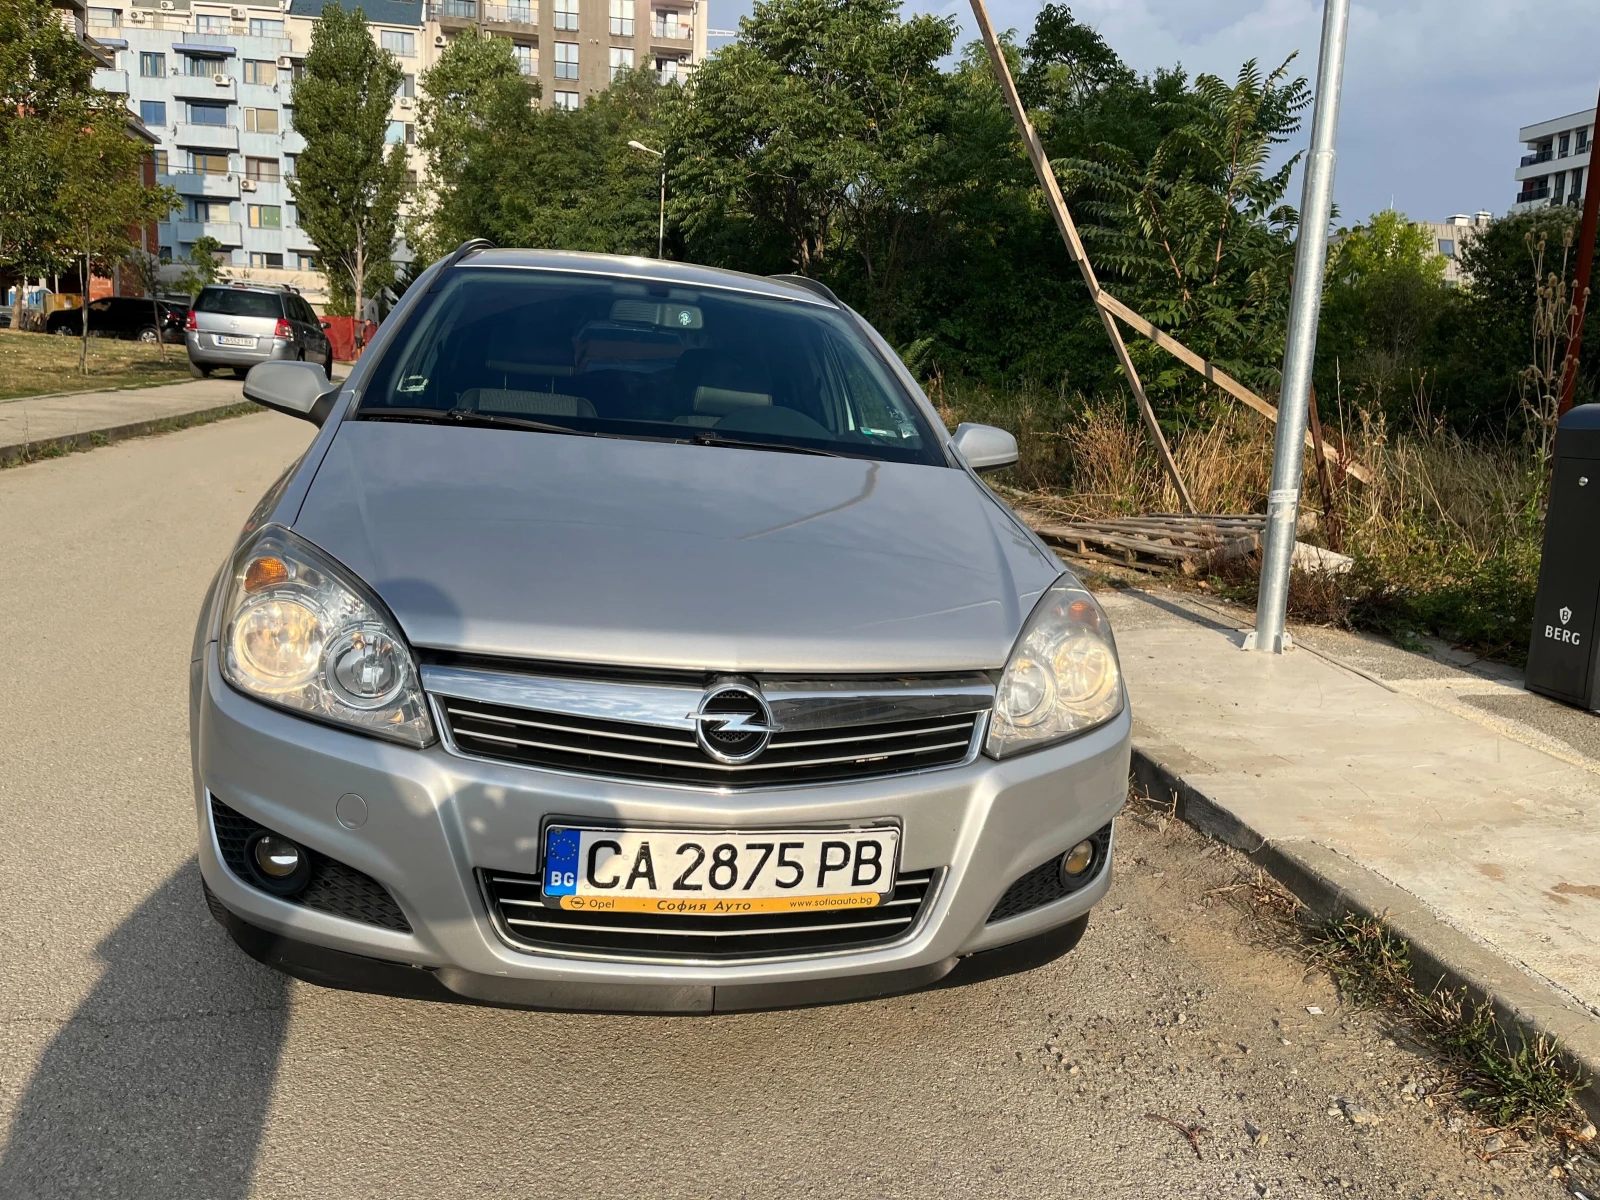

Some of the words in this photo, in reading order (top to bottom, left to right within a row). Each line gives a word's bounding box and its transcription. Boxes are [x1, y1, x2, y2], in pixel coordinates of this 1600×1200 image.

[1545, 625, 1580, 645] BERG
[587, 840, 657, 890] CA
[672, 842, 805, 890] 2875
[817, 840, 882, 888] PB
[551, 871, 575, 887] BG
[589, 899, 615, 910] Opel
[657, 900, 706, 912] София
[713, 901, 751, 912] Ауто
[789, 896, 873, 908] www.sofiaauto.bg
